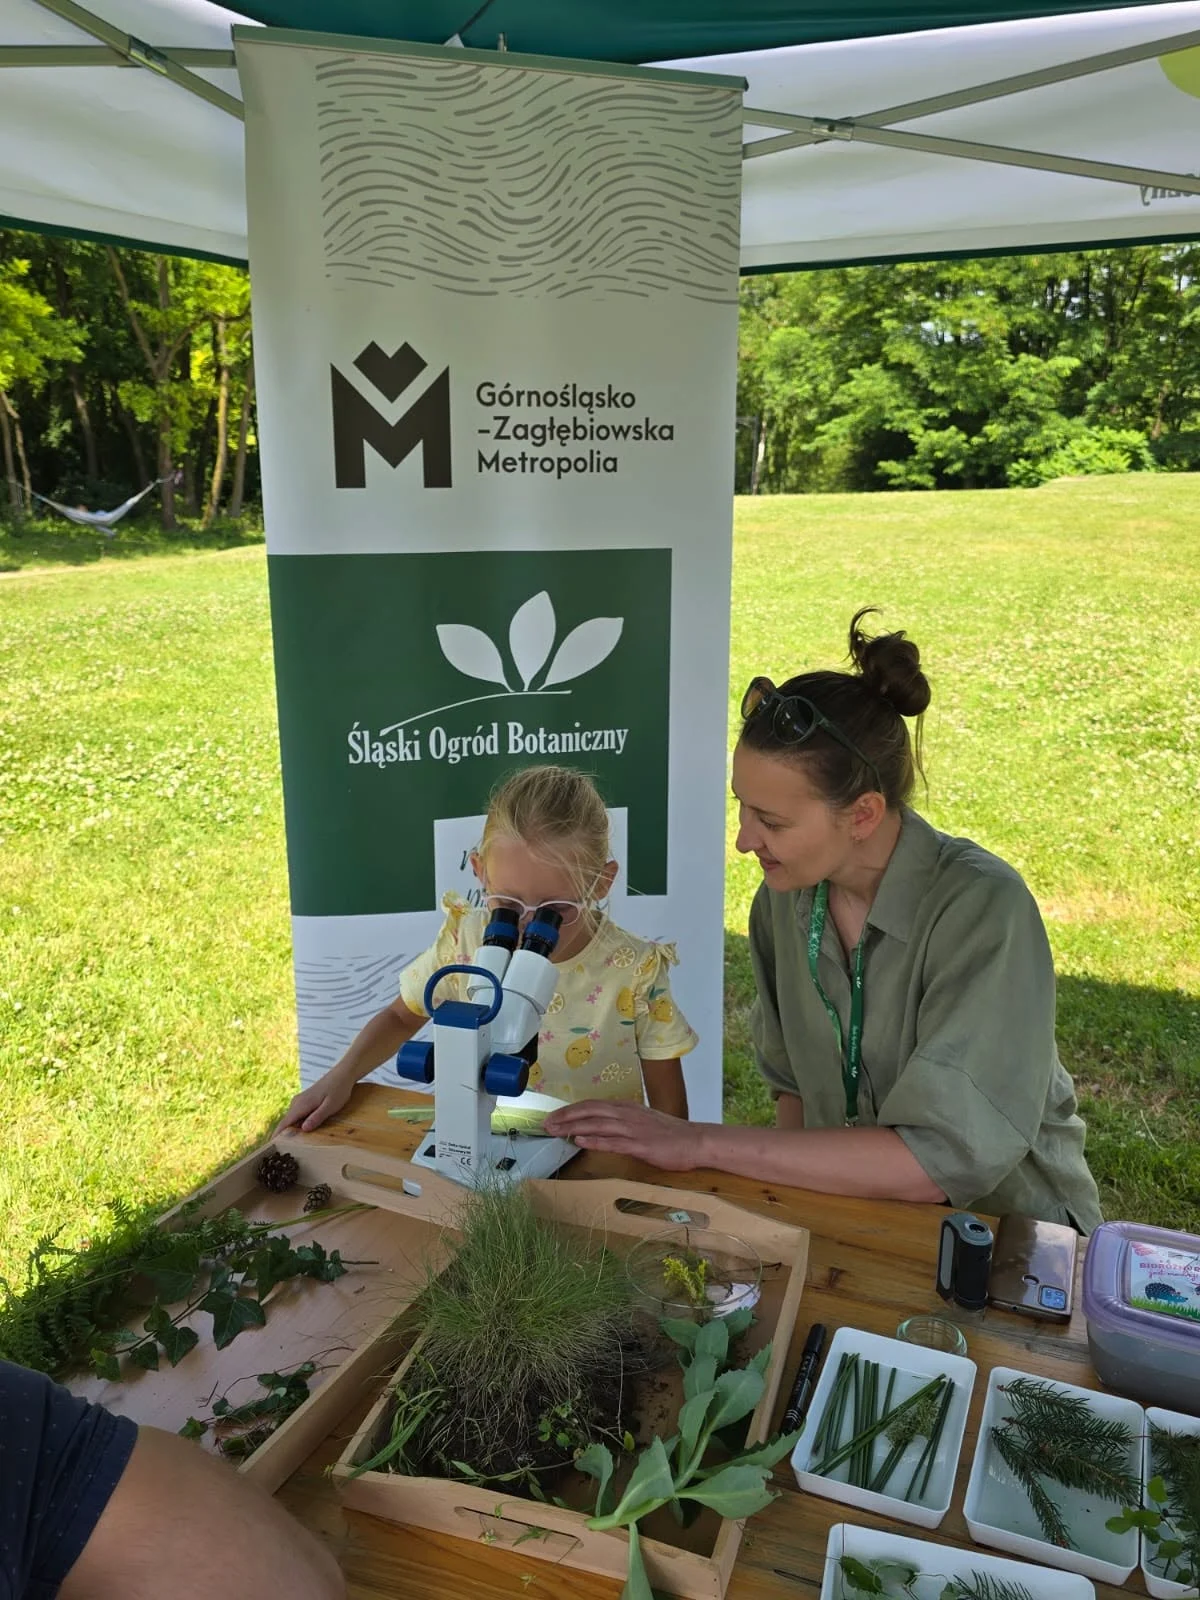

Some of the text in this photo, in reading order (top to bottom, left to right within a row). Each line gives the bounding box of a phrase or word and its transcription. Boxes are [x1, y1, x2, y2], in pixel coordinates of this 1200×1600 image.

[476, 381, 636, 414] Górnośląsko
[477, 415, 675, 447] -Zagłębiowska
[477, 448, 618, 479] Metropolia
[348, 721, 629, 768] Śląski Ogród Botaniczny
